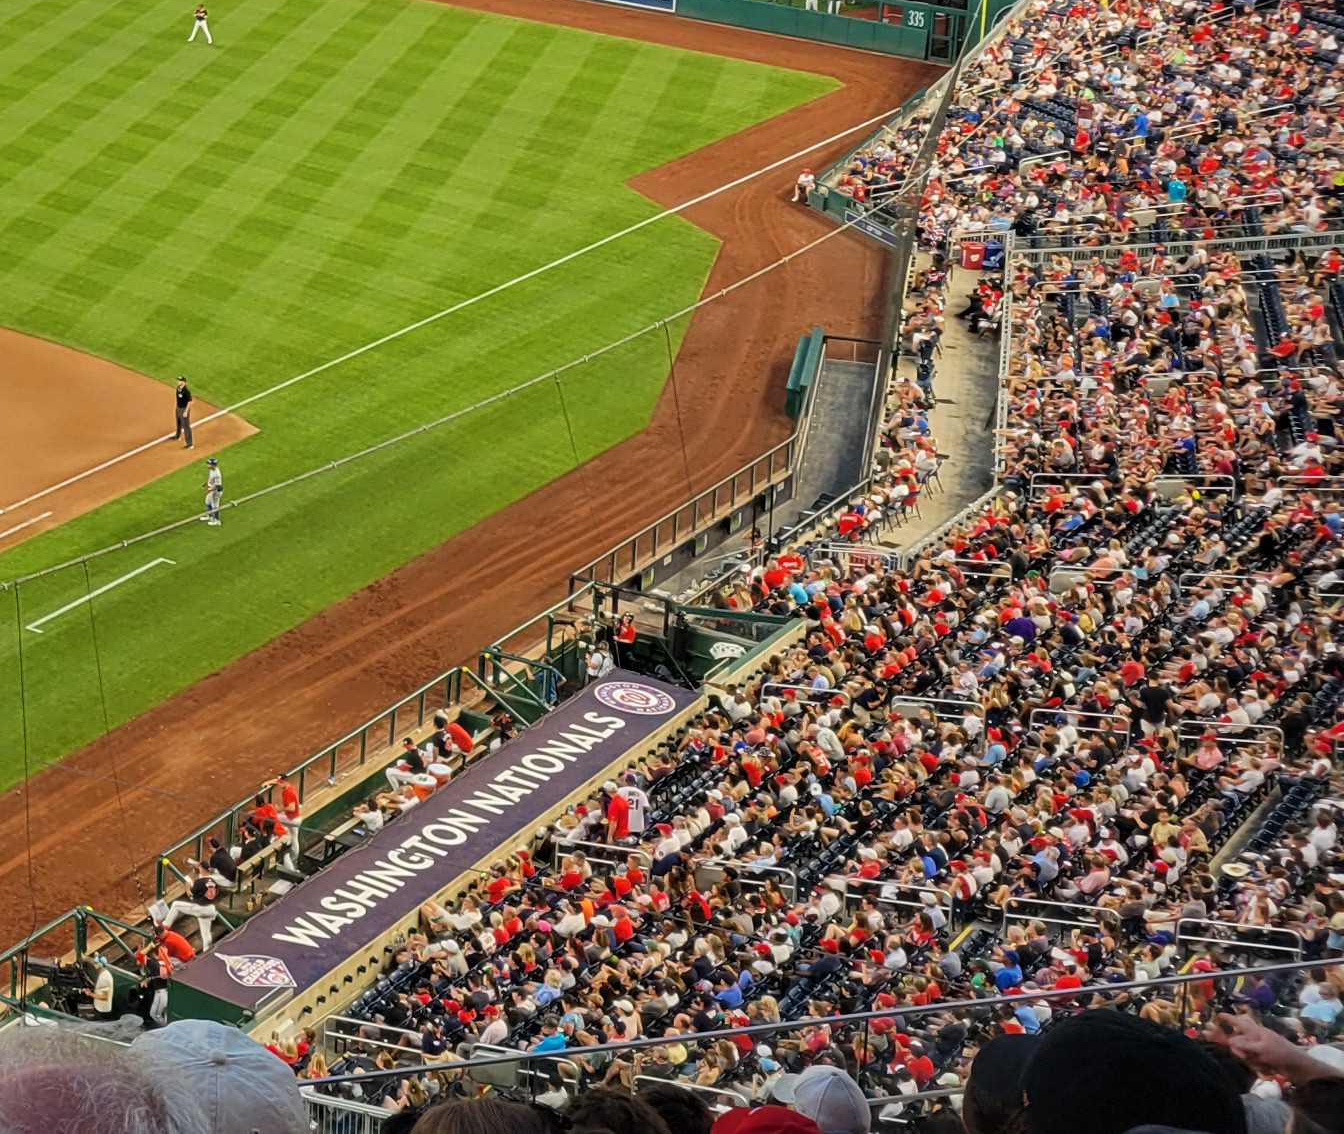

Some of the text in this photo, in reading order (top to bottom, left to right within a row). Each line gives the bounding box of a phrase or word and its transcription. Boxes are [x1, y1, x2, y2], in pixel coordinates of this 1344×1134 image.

[907, 10, 925, 27] 335
[271, 711, 626, 949] WASHINGTON NATIONALS
